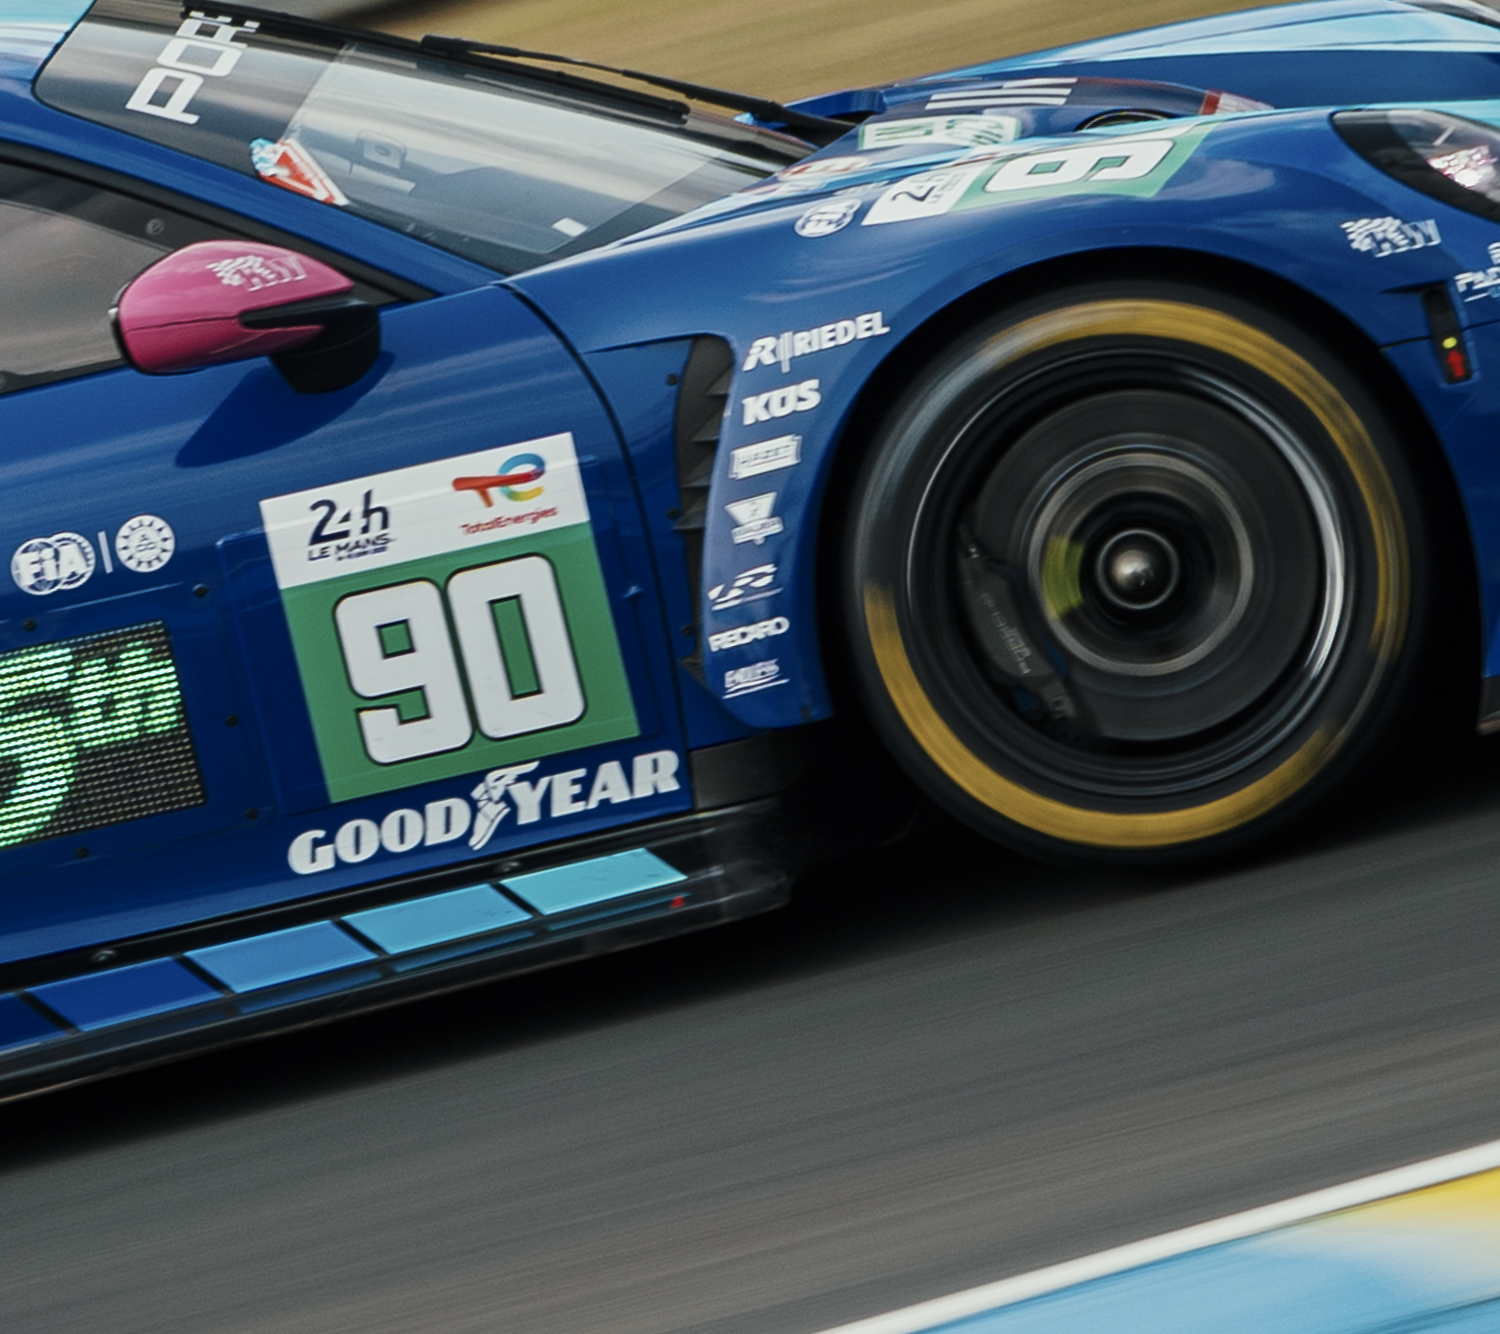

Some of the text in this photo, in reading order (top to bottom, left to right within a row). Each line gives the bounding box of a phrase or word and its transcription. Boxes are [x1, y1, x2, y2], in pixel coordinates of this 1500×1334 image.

[125, 11, 260, 124] POR
[308, 488, 389, 546] 24h
[332, 552, 588, 766] 90
[287, 748, 681, 875] GOODYEAR
